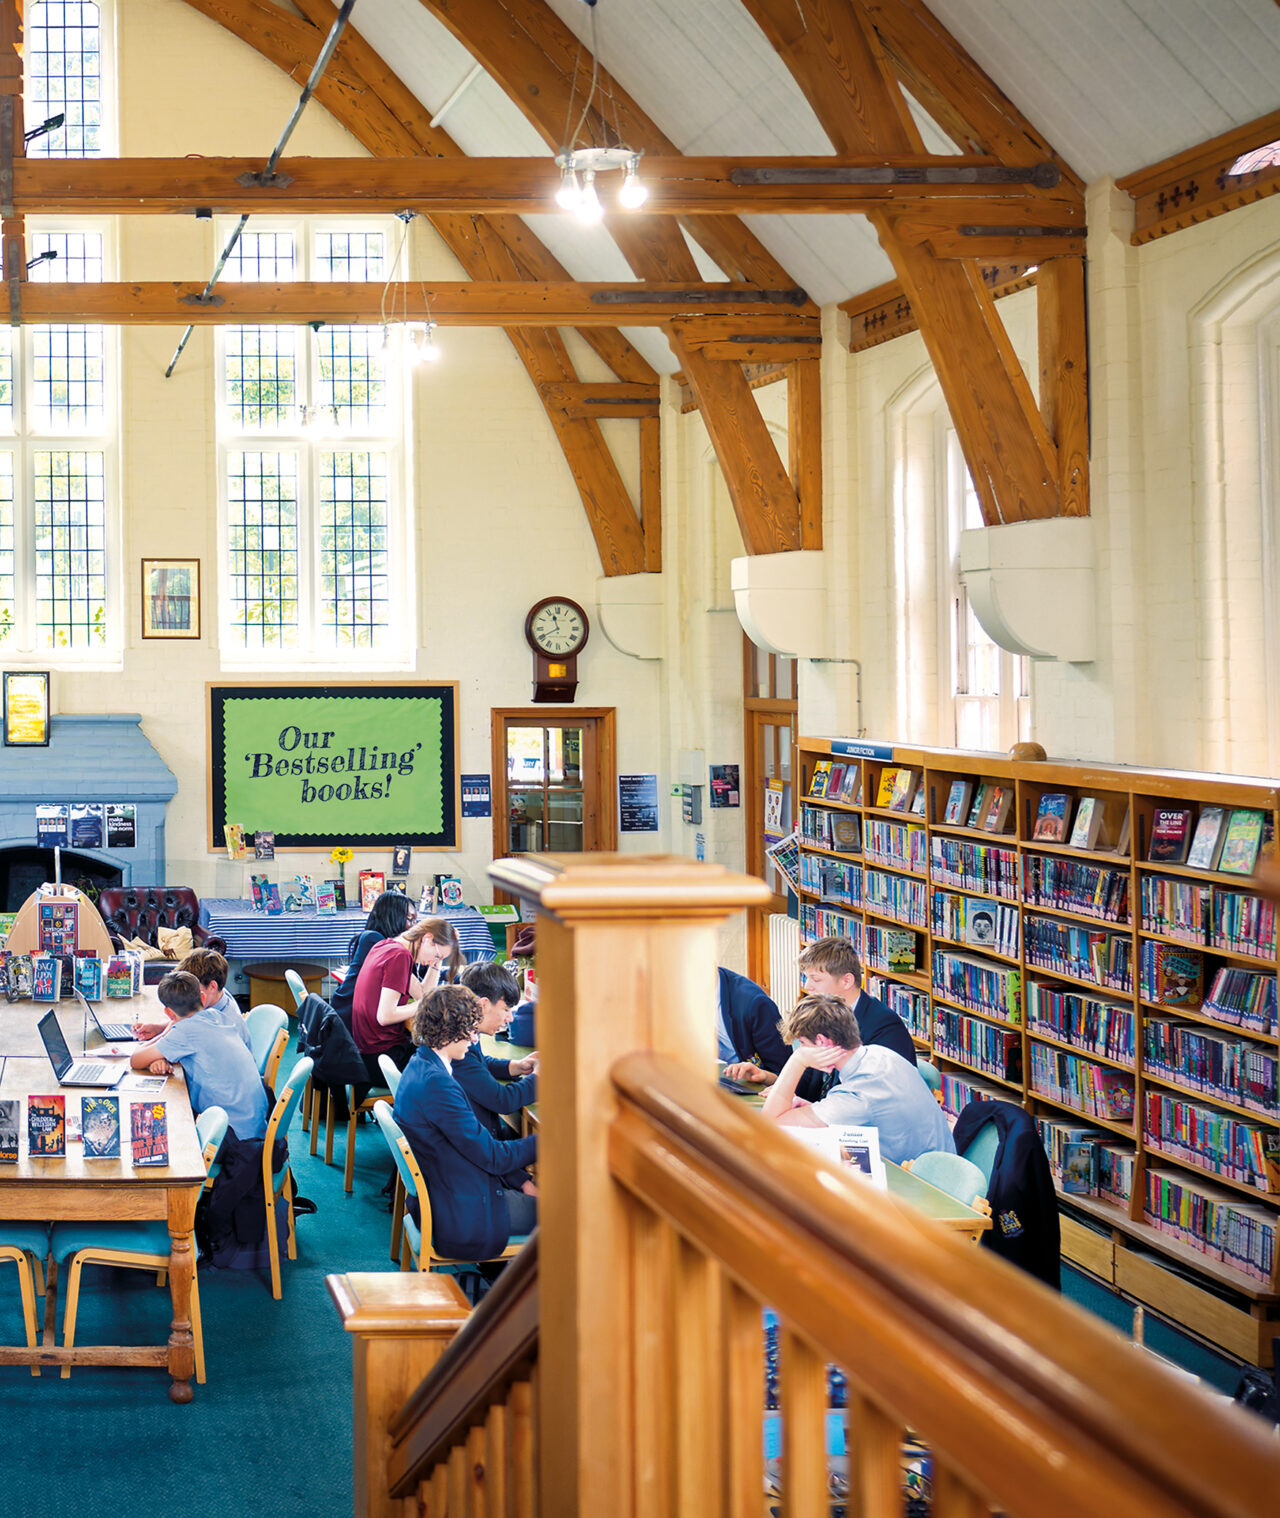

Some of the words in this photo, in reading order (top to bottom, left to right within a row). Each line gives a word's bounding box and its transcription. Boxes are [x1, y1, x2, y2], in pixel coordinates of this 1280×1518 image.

[278, 726, 335, 751] Our
[846, 745, 860, 754] JUNIOR
[860, 747, 875, 756] FICTION
[300, 773, 392, 803] books!
[1160, 812, 1183, 820] OVER
[37, 962, 53, 971] ONCE
[103, 1098, 117, 1114] OVER
